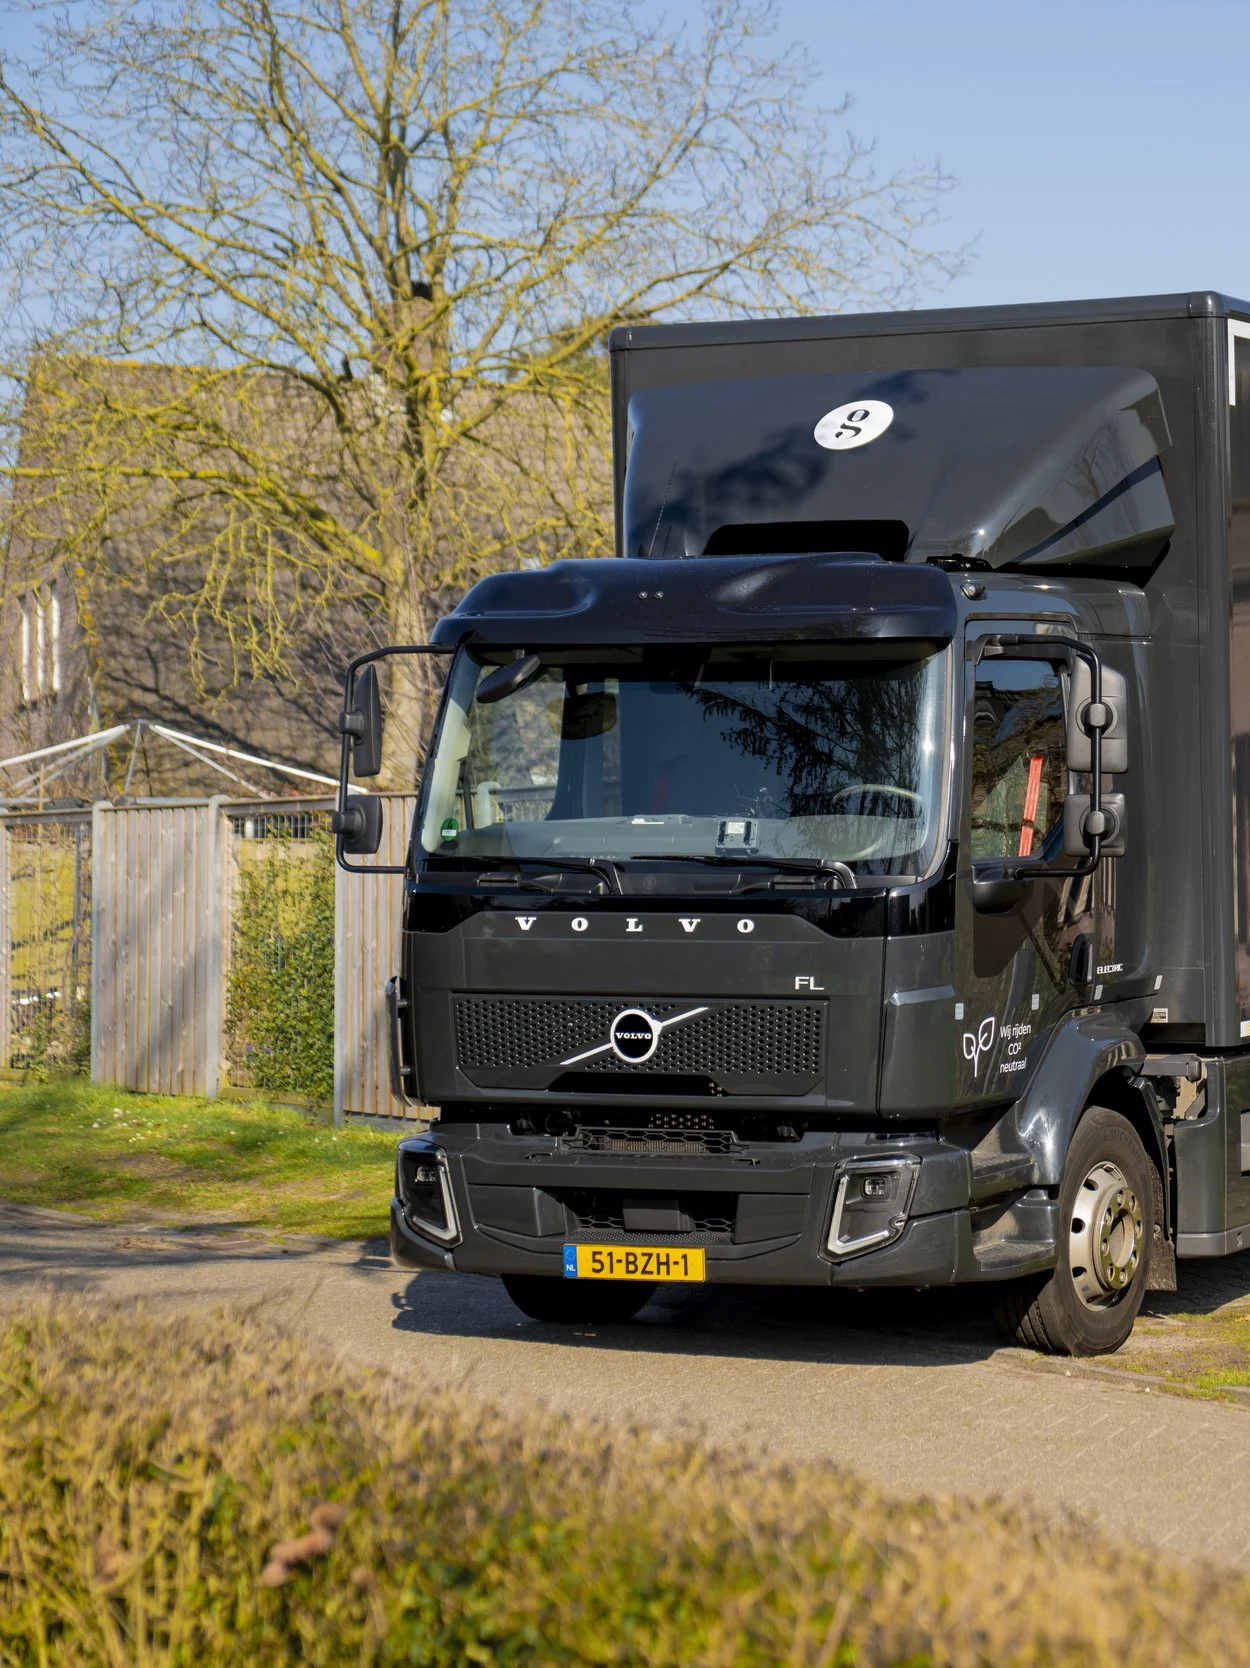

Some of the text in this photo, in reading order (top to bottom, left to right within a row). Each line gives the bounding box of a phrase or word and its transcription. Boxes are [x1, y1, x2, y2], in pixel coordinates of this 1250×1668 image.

[515, 916, 755, 933] VOLVO
[1096, 963, 1123, 974] ELECTRIC
[794, 976, 825, 990] FL
[615, 1032, 652, 1040] VOLVO
[1000, 1022, 1031, 1040] Wij rijden
[1000, 1057, 1027, 1073] neutraal
[566, 1264, 576, 1272] NL
[591, 1250, 689, 1277] 51-BZH-1
